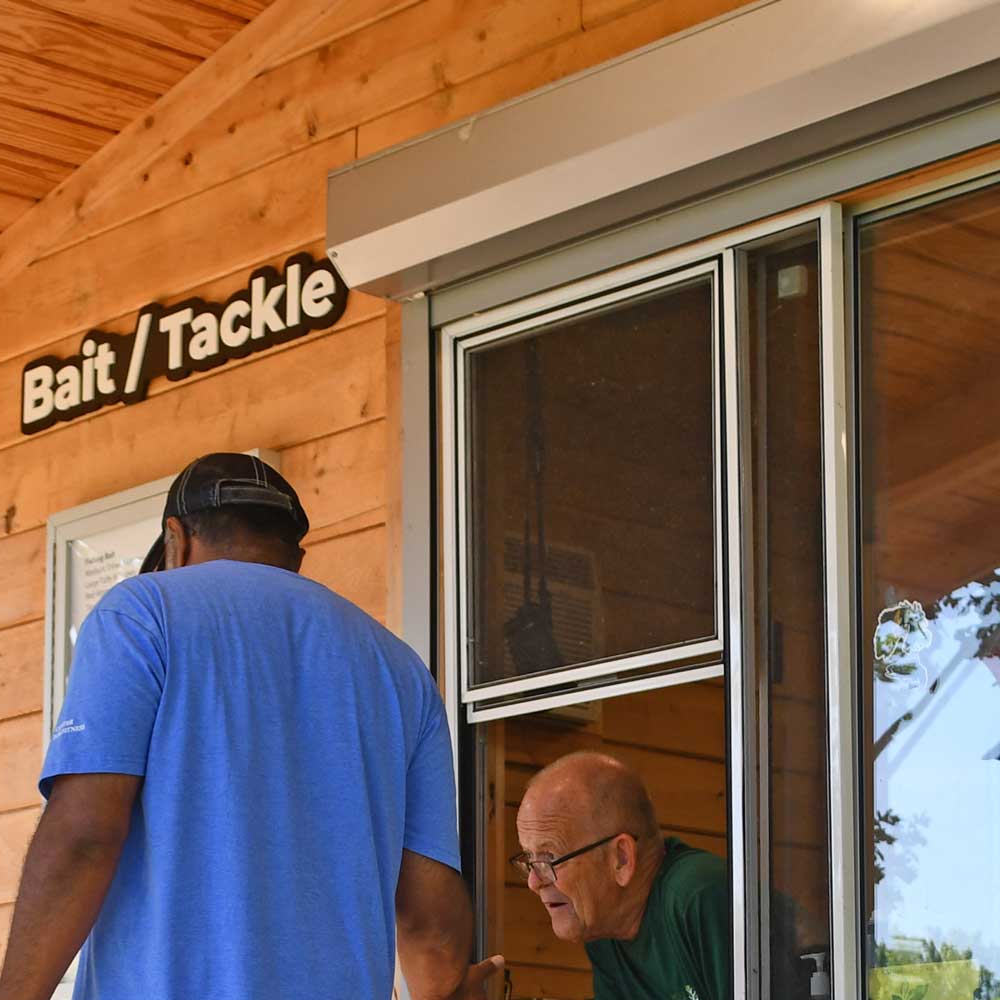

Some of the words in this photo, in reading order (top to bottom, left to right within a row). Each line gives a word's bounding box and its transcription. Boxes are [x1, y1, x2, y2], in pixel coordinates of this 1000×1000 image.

[22, 339, 116, 425] Bait
[124, 313, 152, 394] /
[159, 263, 337, 371] Tackle
